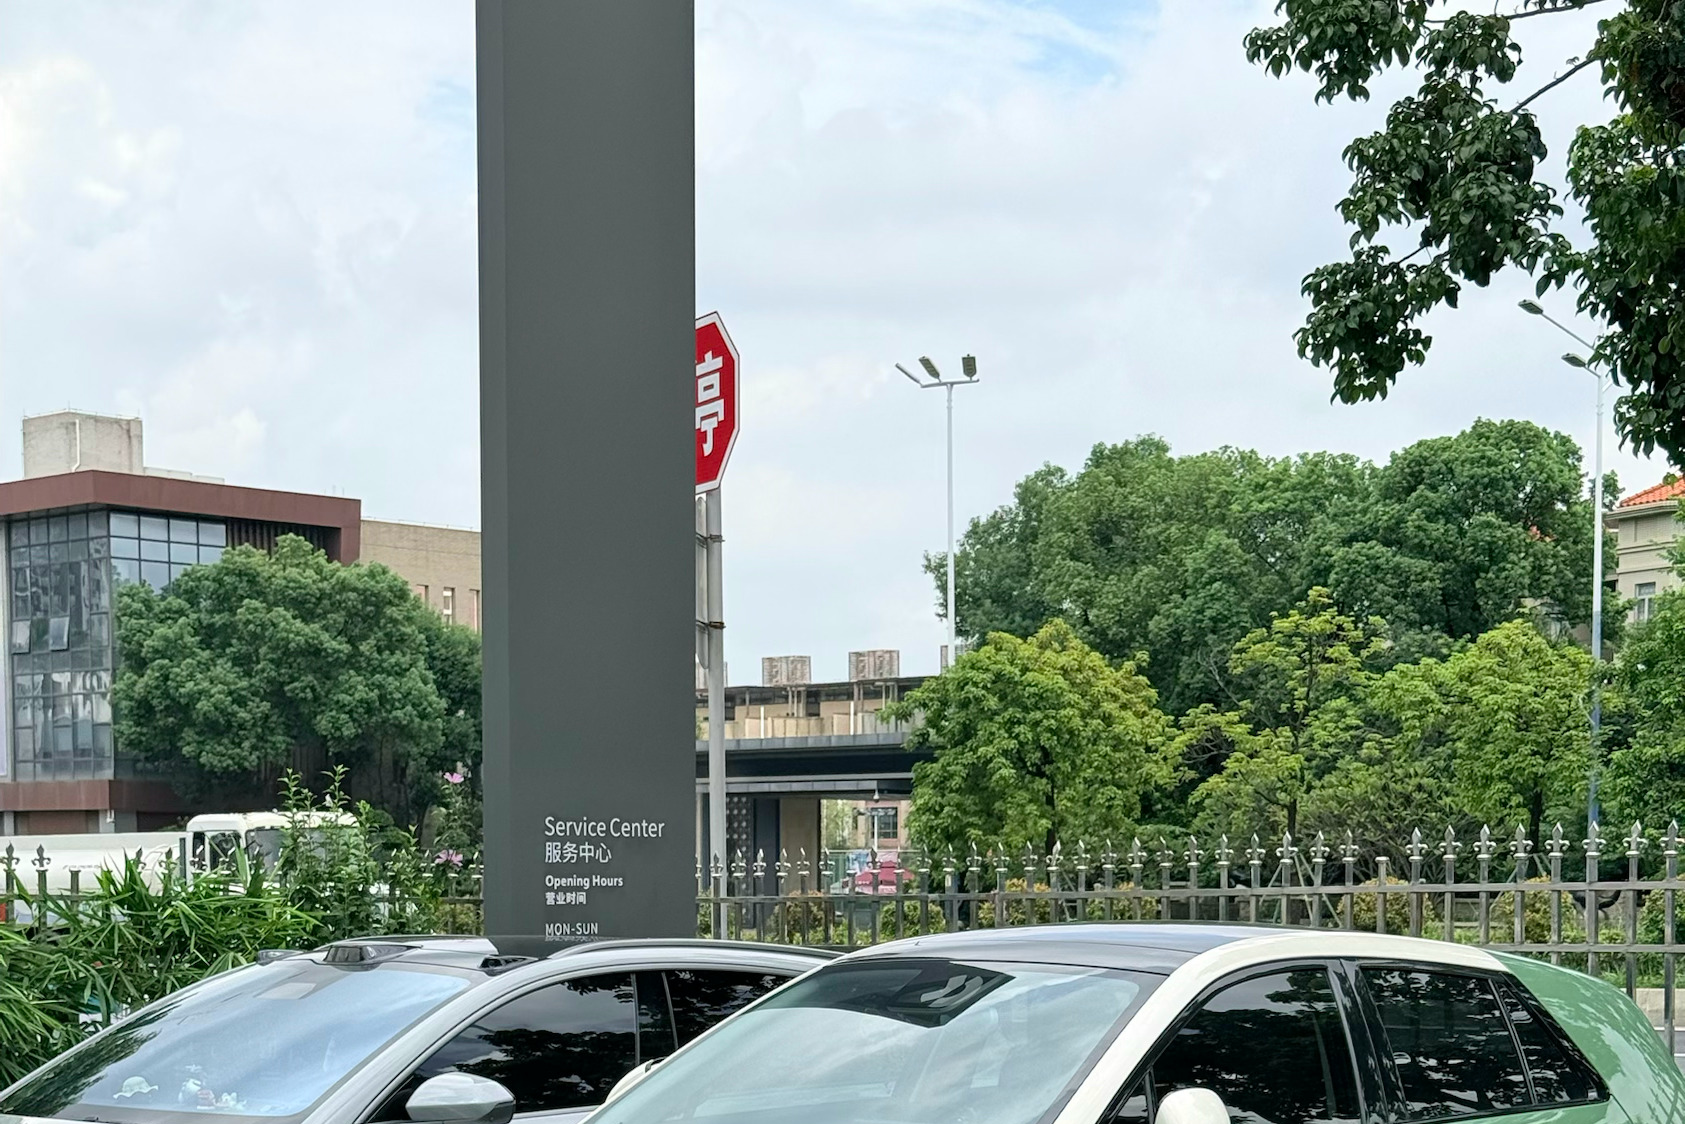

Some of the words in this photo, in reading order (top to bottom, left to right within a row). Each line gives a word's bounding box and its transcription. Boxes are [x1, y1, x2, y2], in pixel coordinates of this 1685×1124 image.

[544, 816, 606, 837] Service
[610, 818, 665, 838] Center
[545, 842, 612, 863] 服务中心
[545, 874, 590, 889] Opening
[592, 875, 623, 887] Hours
[545, 892, 586, 905] 营业时间
[545, 922, 598, 936] MON-SUN
